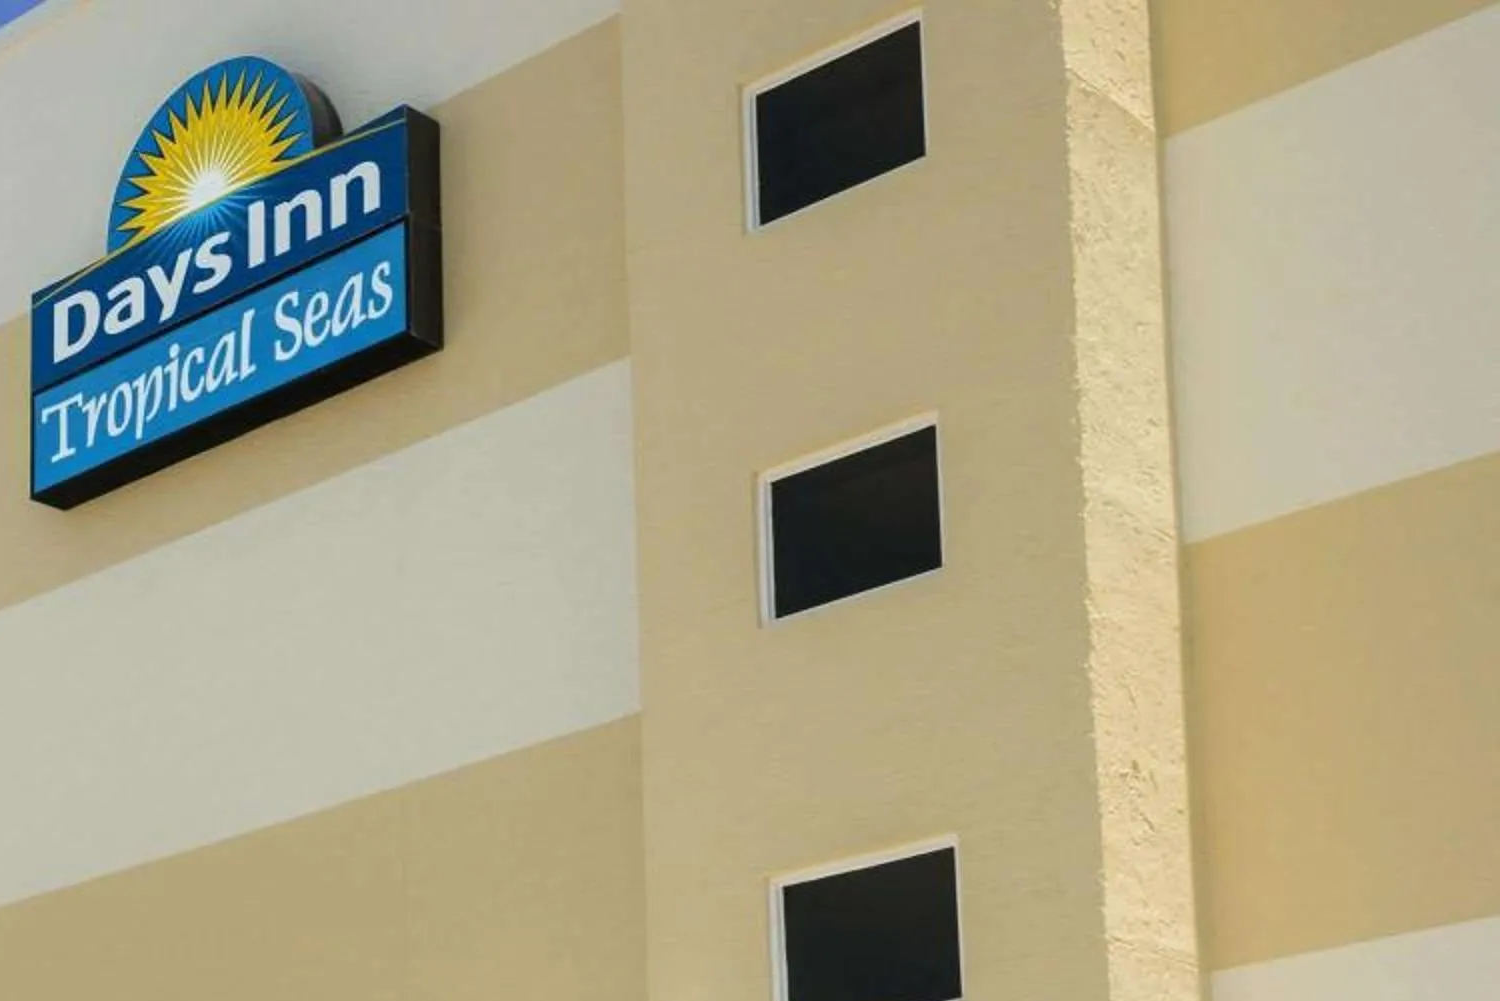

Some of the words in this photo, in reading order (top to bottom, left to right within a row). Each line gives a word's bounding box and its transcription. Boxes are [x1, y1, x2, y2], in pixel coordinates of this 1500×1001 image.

[41, 308, 256, 463] Tropical
[274, 261, 394, 362] Seas
[53, 231, 231, 364] Days
[247, 160, 381, 269] Inn
